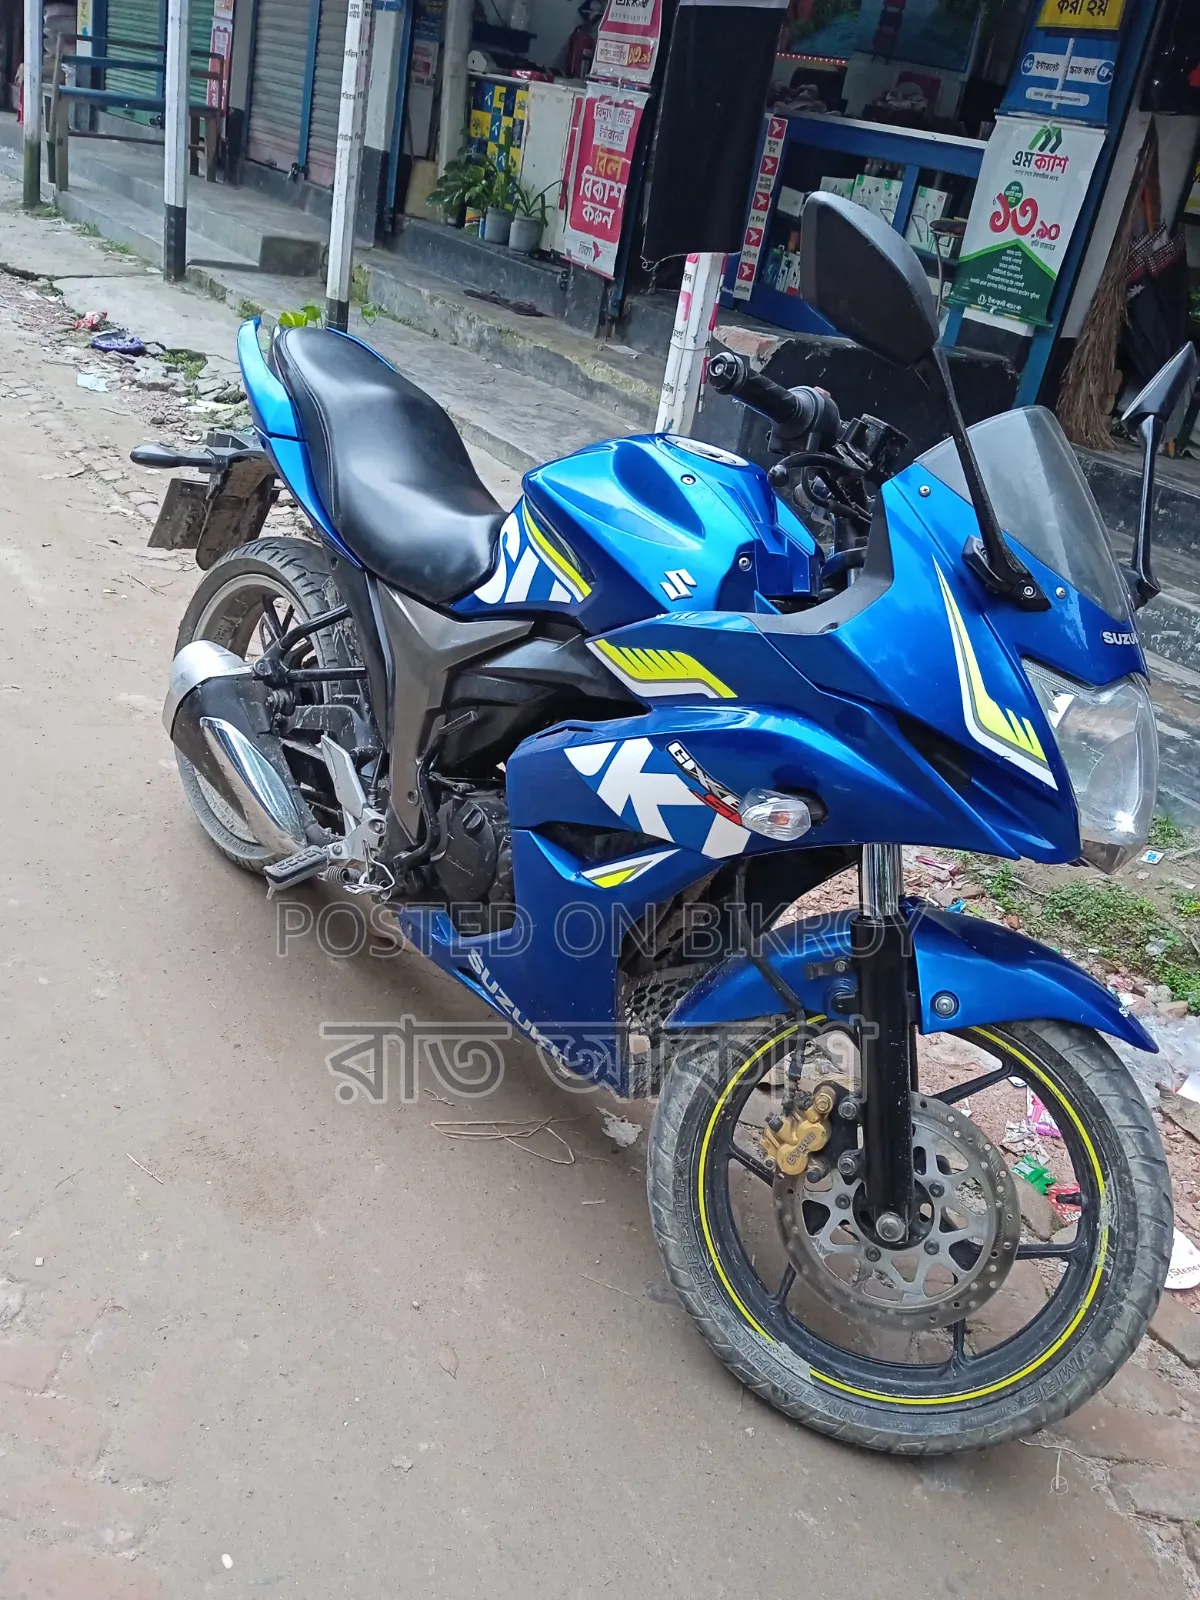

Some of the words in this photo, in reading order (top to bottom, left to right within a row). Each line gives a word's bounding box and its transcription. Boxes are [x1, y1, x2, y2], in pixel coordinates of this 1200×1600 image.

[593, 144, 623, 181] বিল
[1012, 150, 1035, 169] এম
[1034, 153, 1069, 174] ক্যাশ
[579, 165, 627, 208] বিকাশ
[582, 200, 615, 230] করুন
[1102, 631, 1139, 645] SUZU
[667, 741, 742, 813] GIXXE
[468, 948, 569, 1065] SUZUKI
